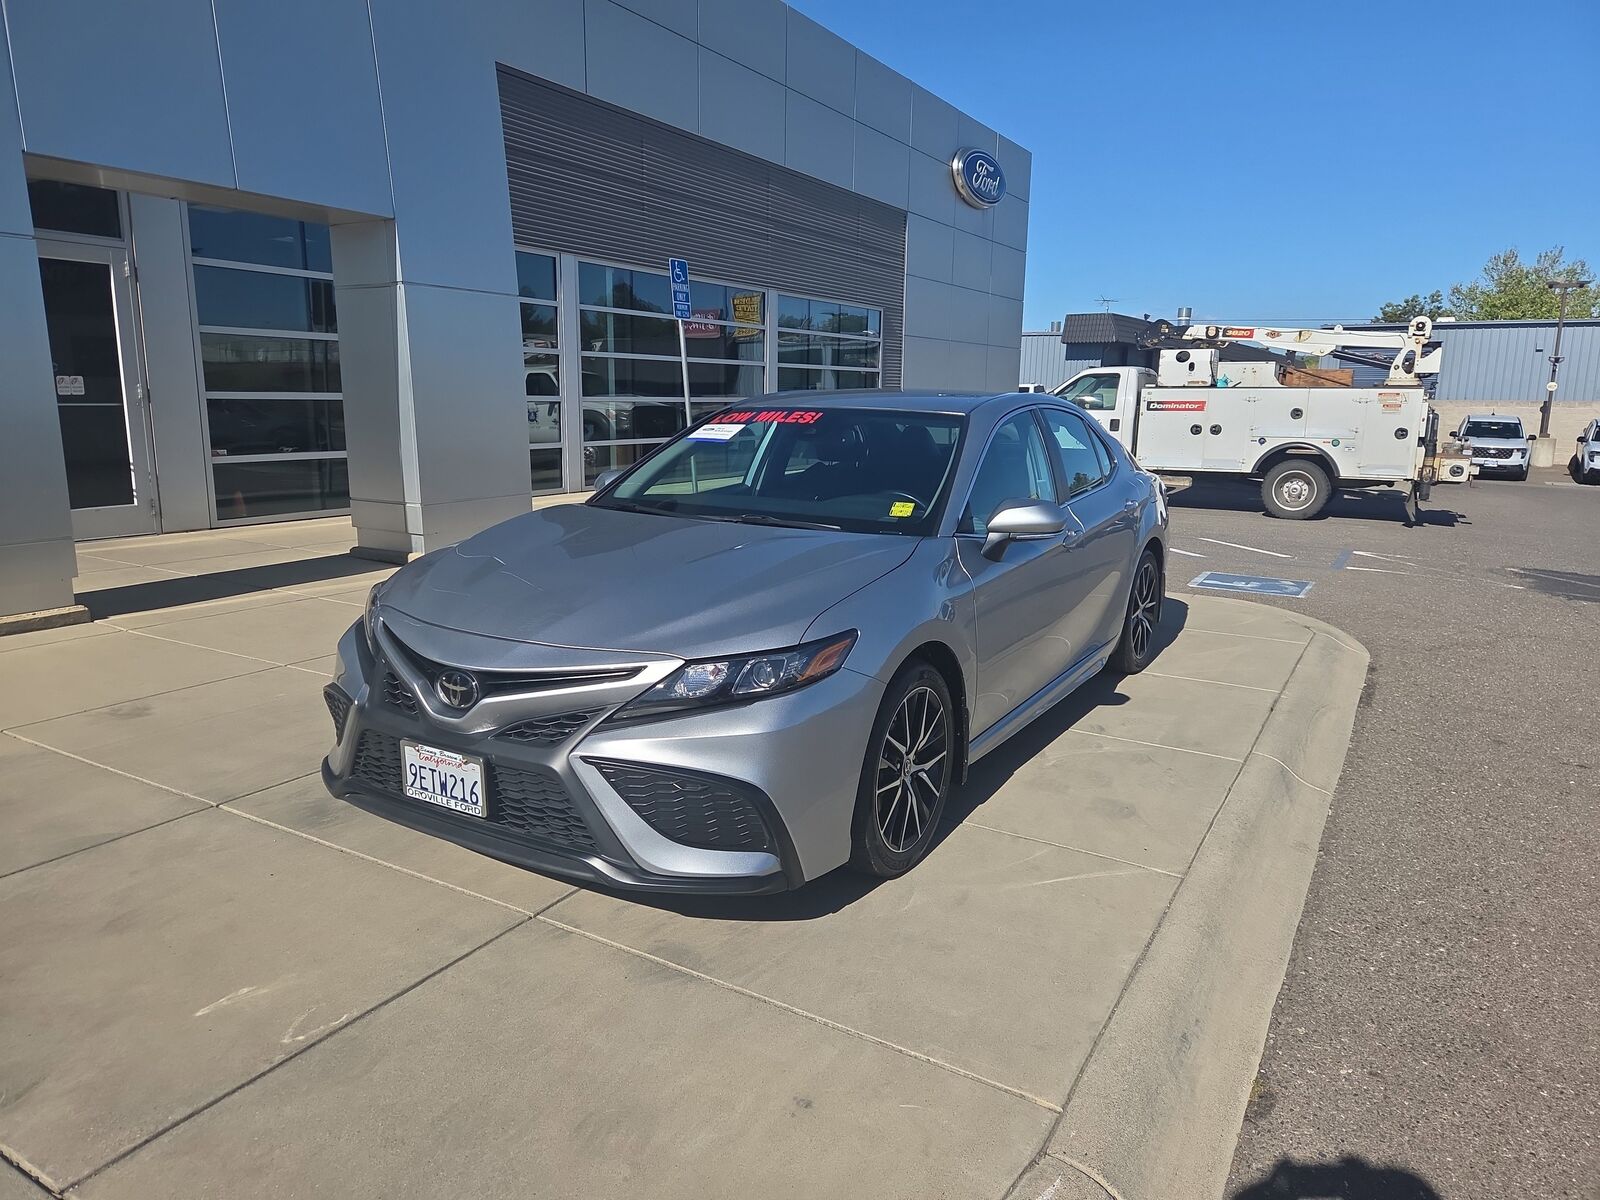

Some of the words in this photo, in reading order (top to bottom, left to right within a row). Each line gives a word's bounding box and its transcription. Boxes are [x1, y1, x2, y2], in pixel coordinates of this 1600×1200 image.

[973, 160, 1000, 195] Ford
[676, 292, 686, 302] ONLY
[1149, 402, 1201, 410] Dominator
[710, 411, 756, 424] LOW
[752, 411, 824, 424] MILES!
[418, 752, 464, 769] California
[409, 763, 479, 804] 9ETW216
[407, 787, 452, 807] OROVILLE
[454, 802, 481, 815] FORD
